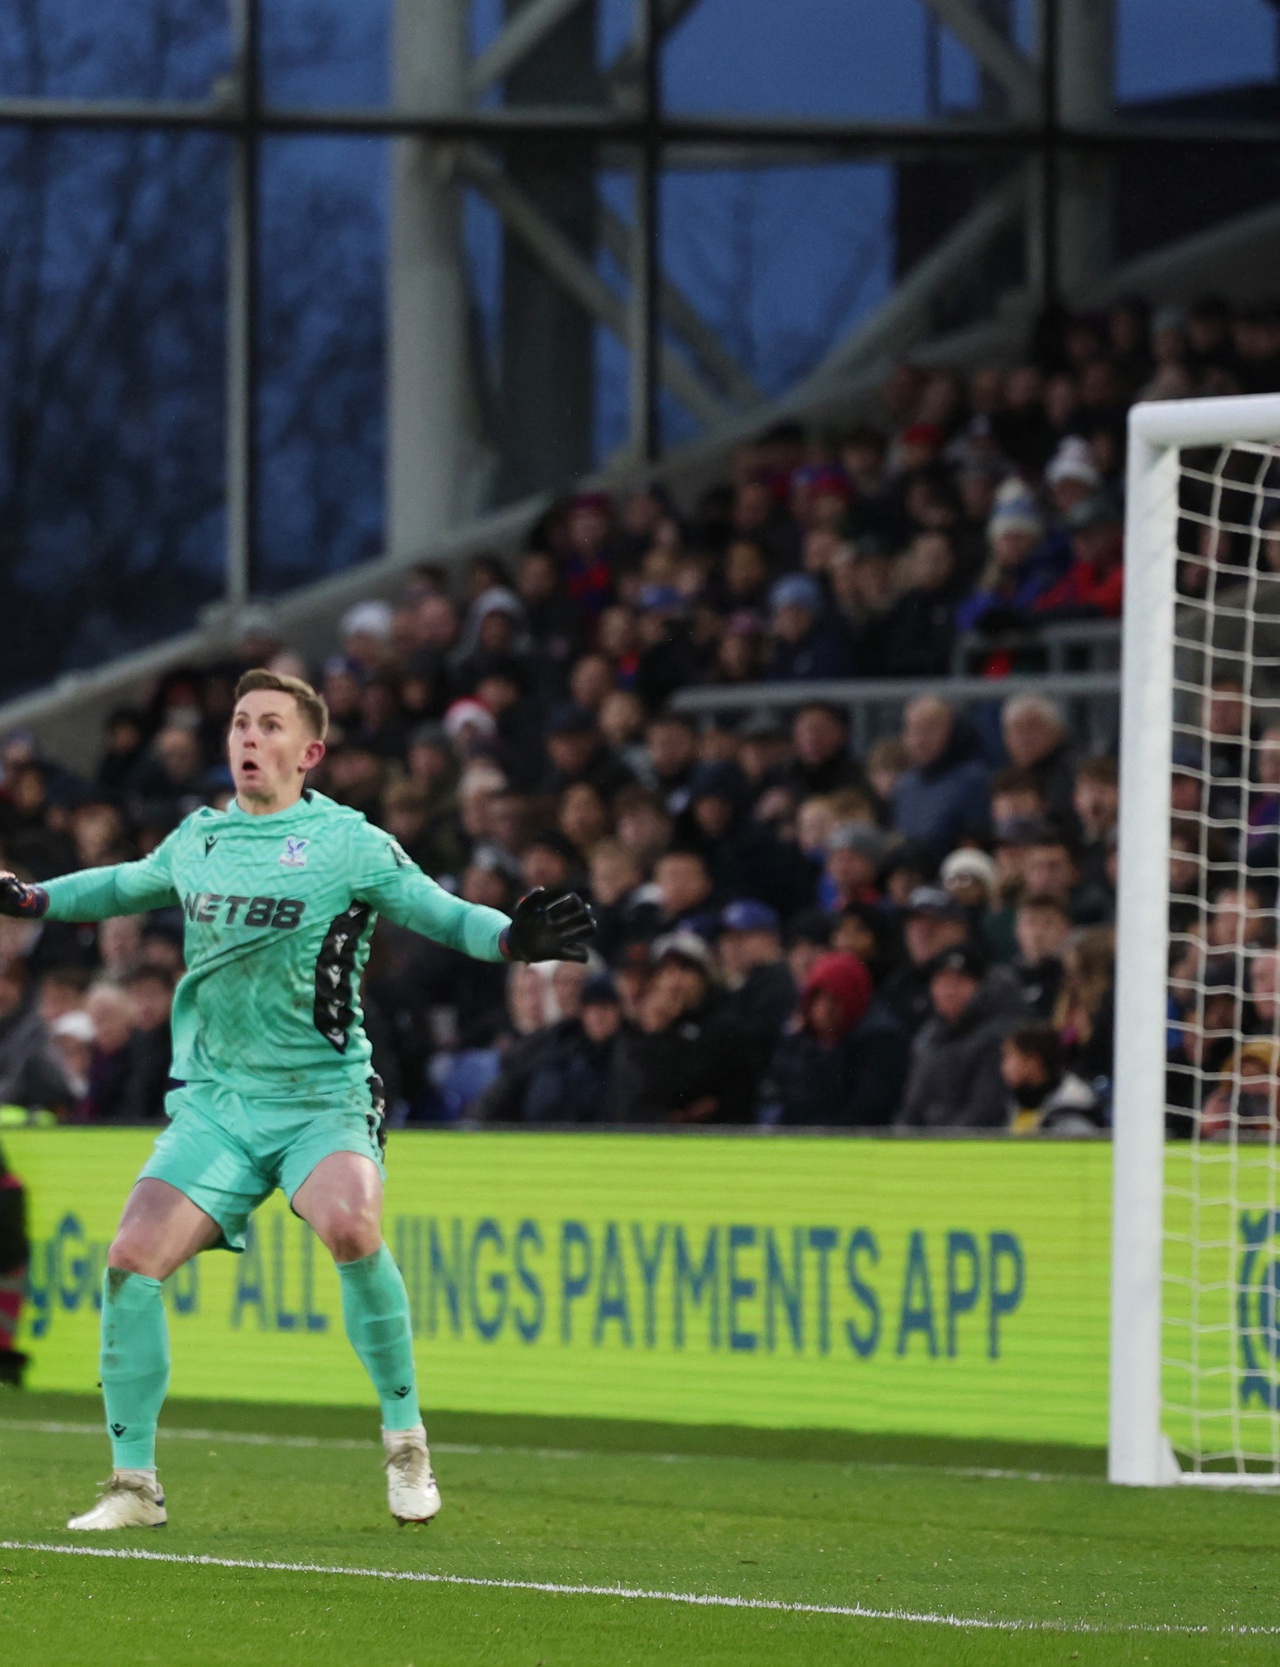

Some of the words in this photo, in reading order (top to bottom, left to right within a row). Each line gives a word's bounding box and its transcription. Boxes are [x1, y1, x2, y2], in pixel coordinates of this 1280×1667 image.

[184, 892, 306, 930] NET88
[560, 1217, 883, 1361] PAYMENTS
[895, 1227, 1026, 1361] APP
